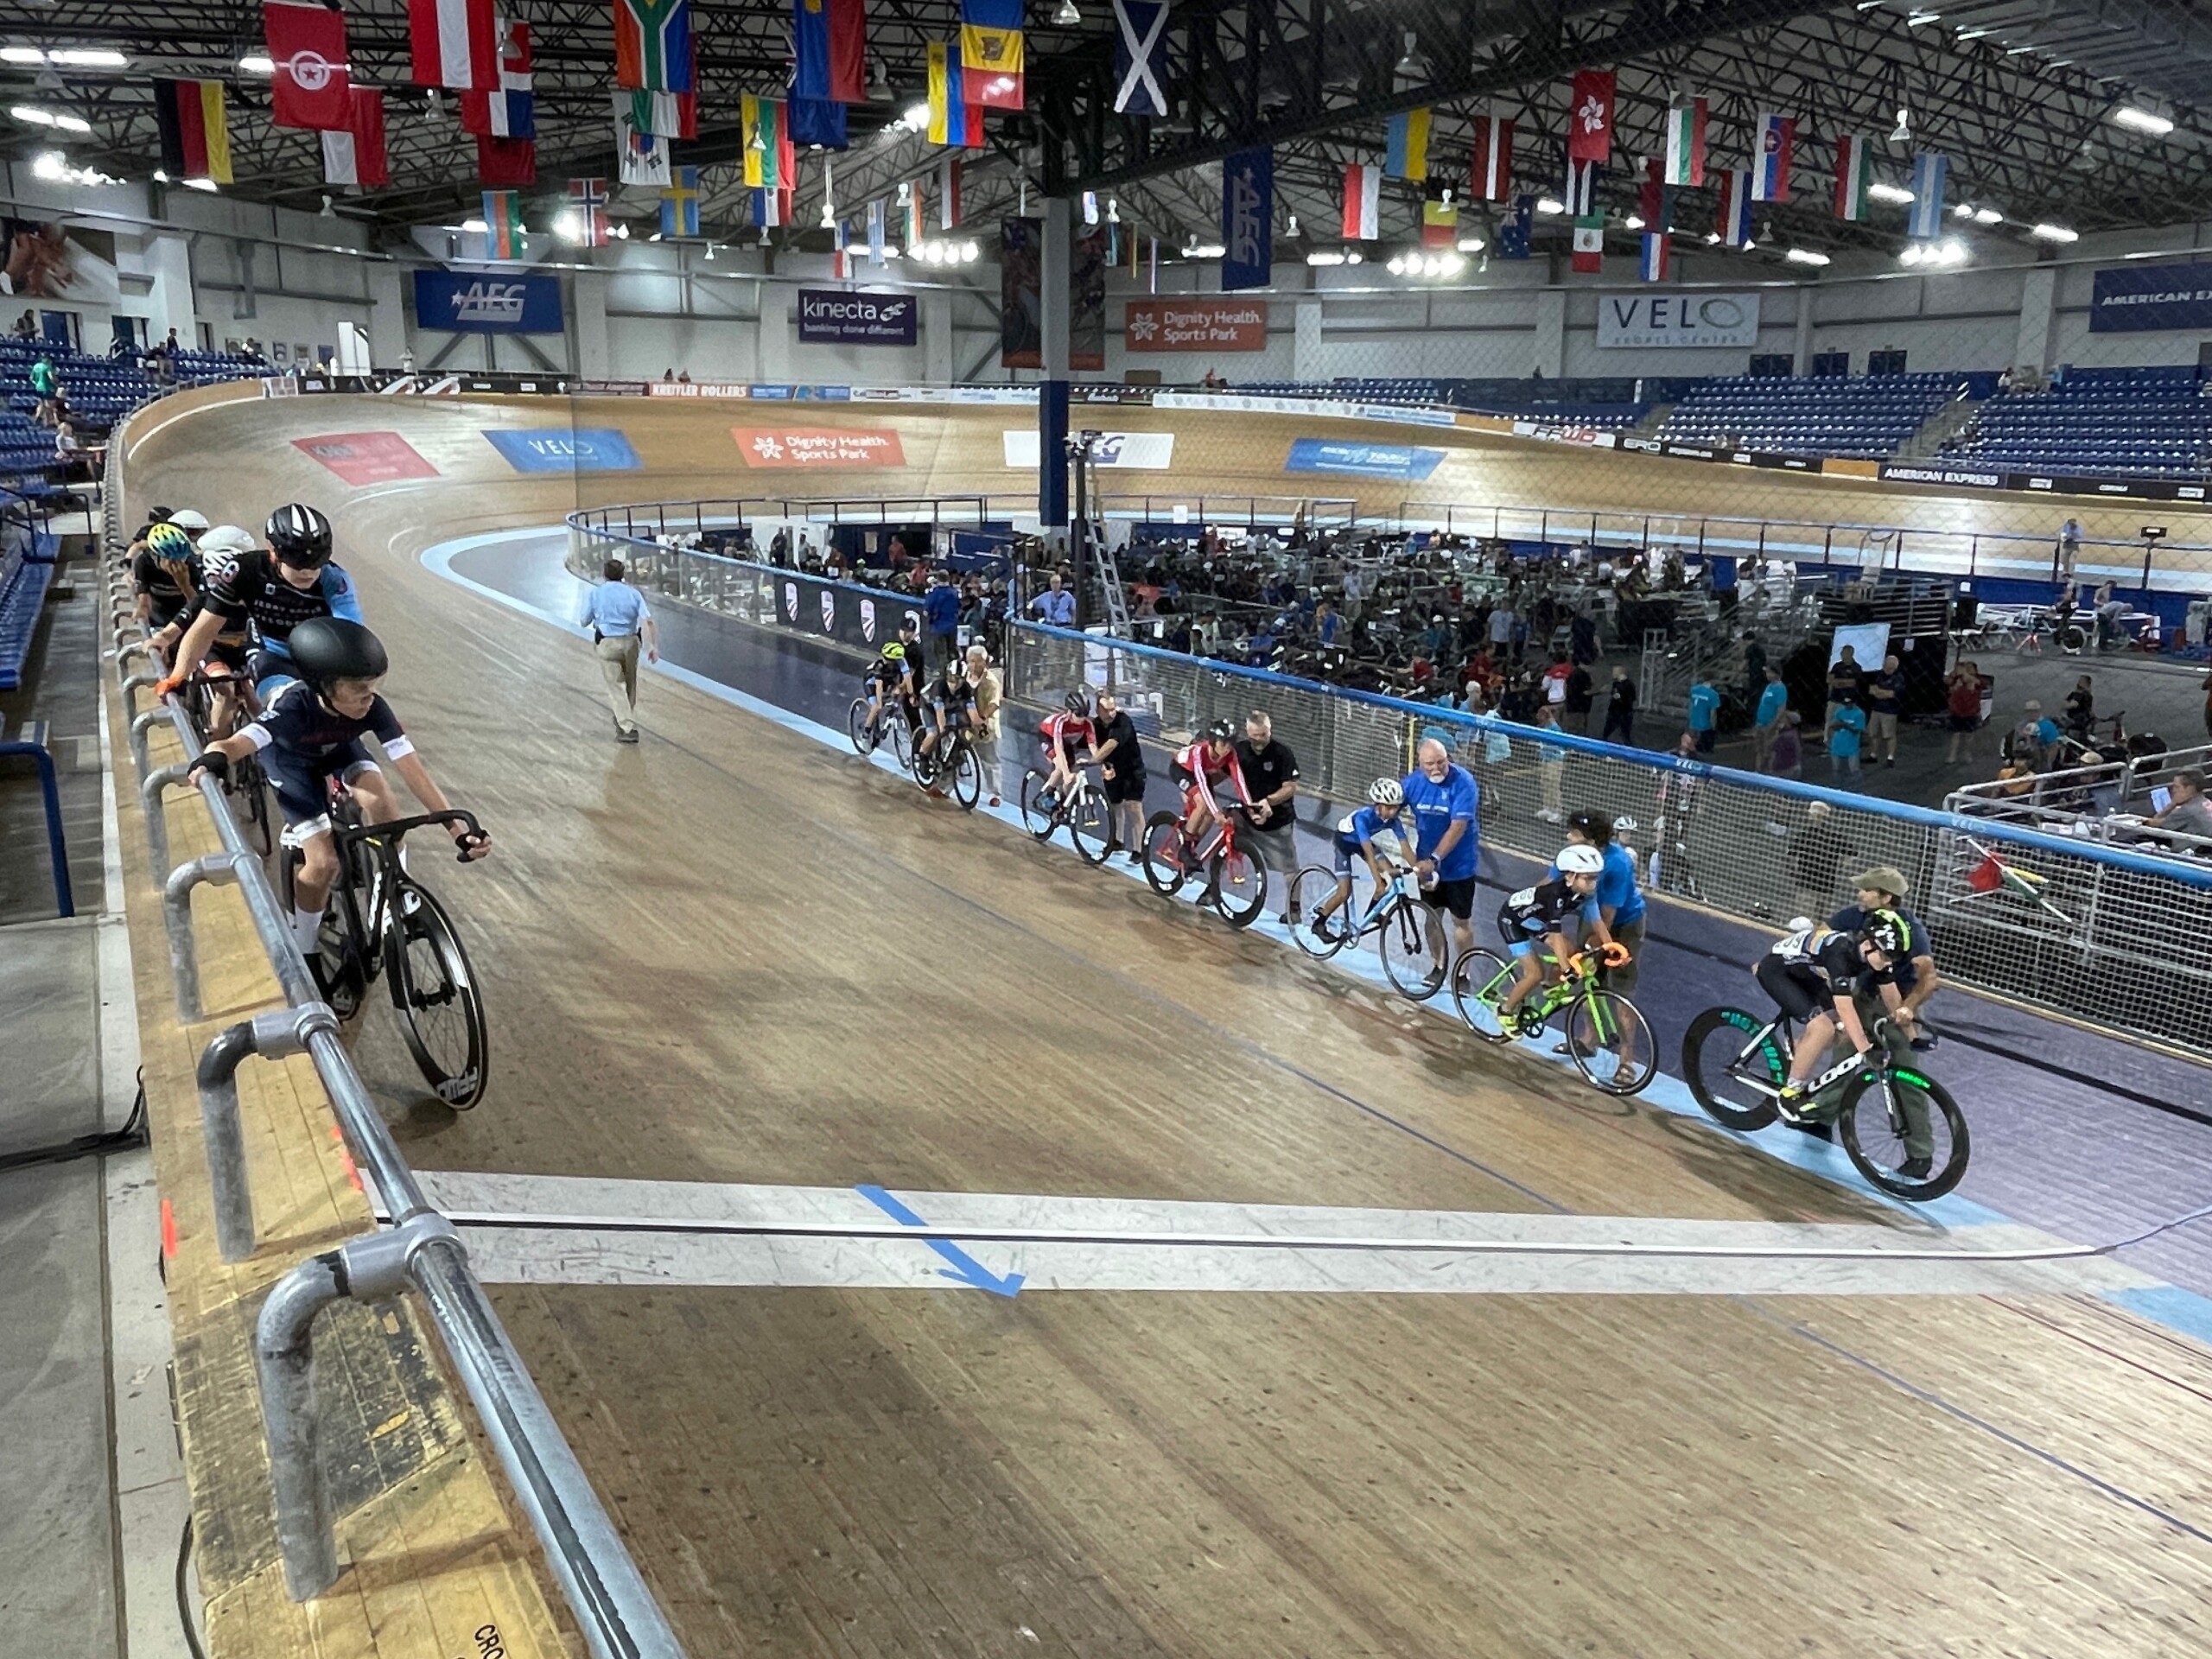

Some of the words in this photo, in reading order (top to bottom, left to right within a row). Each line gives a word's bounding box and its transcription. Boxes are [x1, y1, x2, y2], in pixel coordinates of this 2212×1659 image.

[1233, 175, 1260, 266] AEG
[461, 282, 526, 315] AEG
[2101, 292, 2191, 307] AMERICAN
[804, 296, 876, 320] kinecta
[1613, 298, 1745, 329] VELO
[1164, 311, 1211, 327] Dignity
[1164, 328, 1206, 344] Sports
[1210, 327, 1238, 340] Park
[528, 439, 594, 455] VELO
[785, 436, 836, 449] Dignity
[791, 448, 837, 462] Sports
[838, 448, 870, 460] Park
[1885, 468, 1943, 482] AMERICAN
[1944, 472, 1999, 486] EXPRESS
